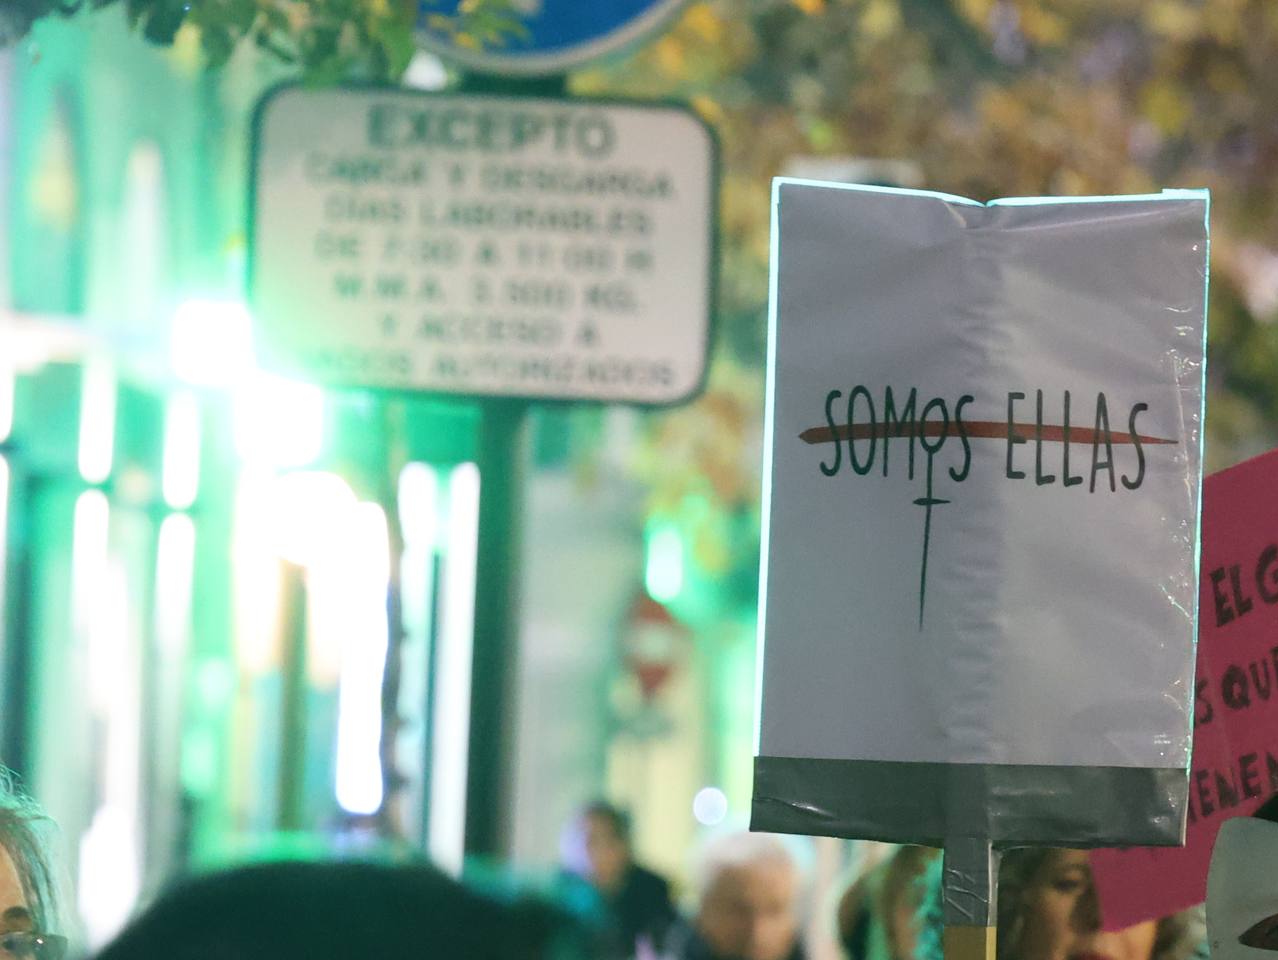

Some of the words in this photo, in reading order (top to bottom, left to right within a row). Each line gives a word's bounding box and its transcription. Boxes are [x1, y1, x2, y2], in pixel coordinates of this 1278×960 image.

[367, 103, 617, 157] EXCEPTO
[820, 385, 975, 483] SOMOS
[1005, 389, 1148, 493] ELLAS
[1210, 564, 1253, 628] EL
